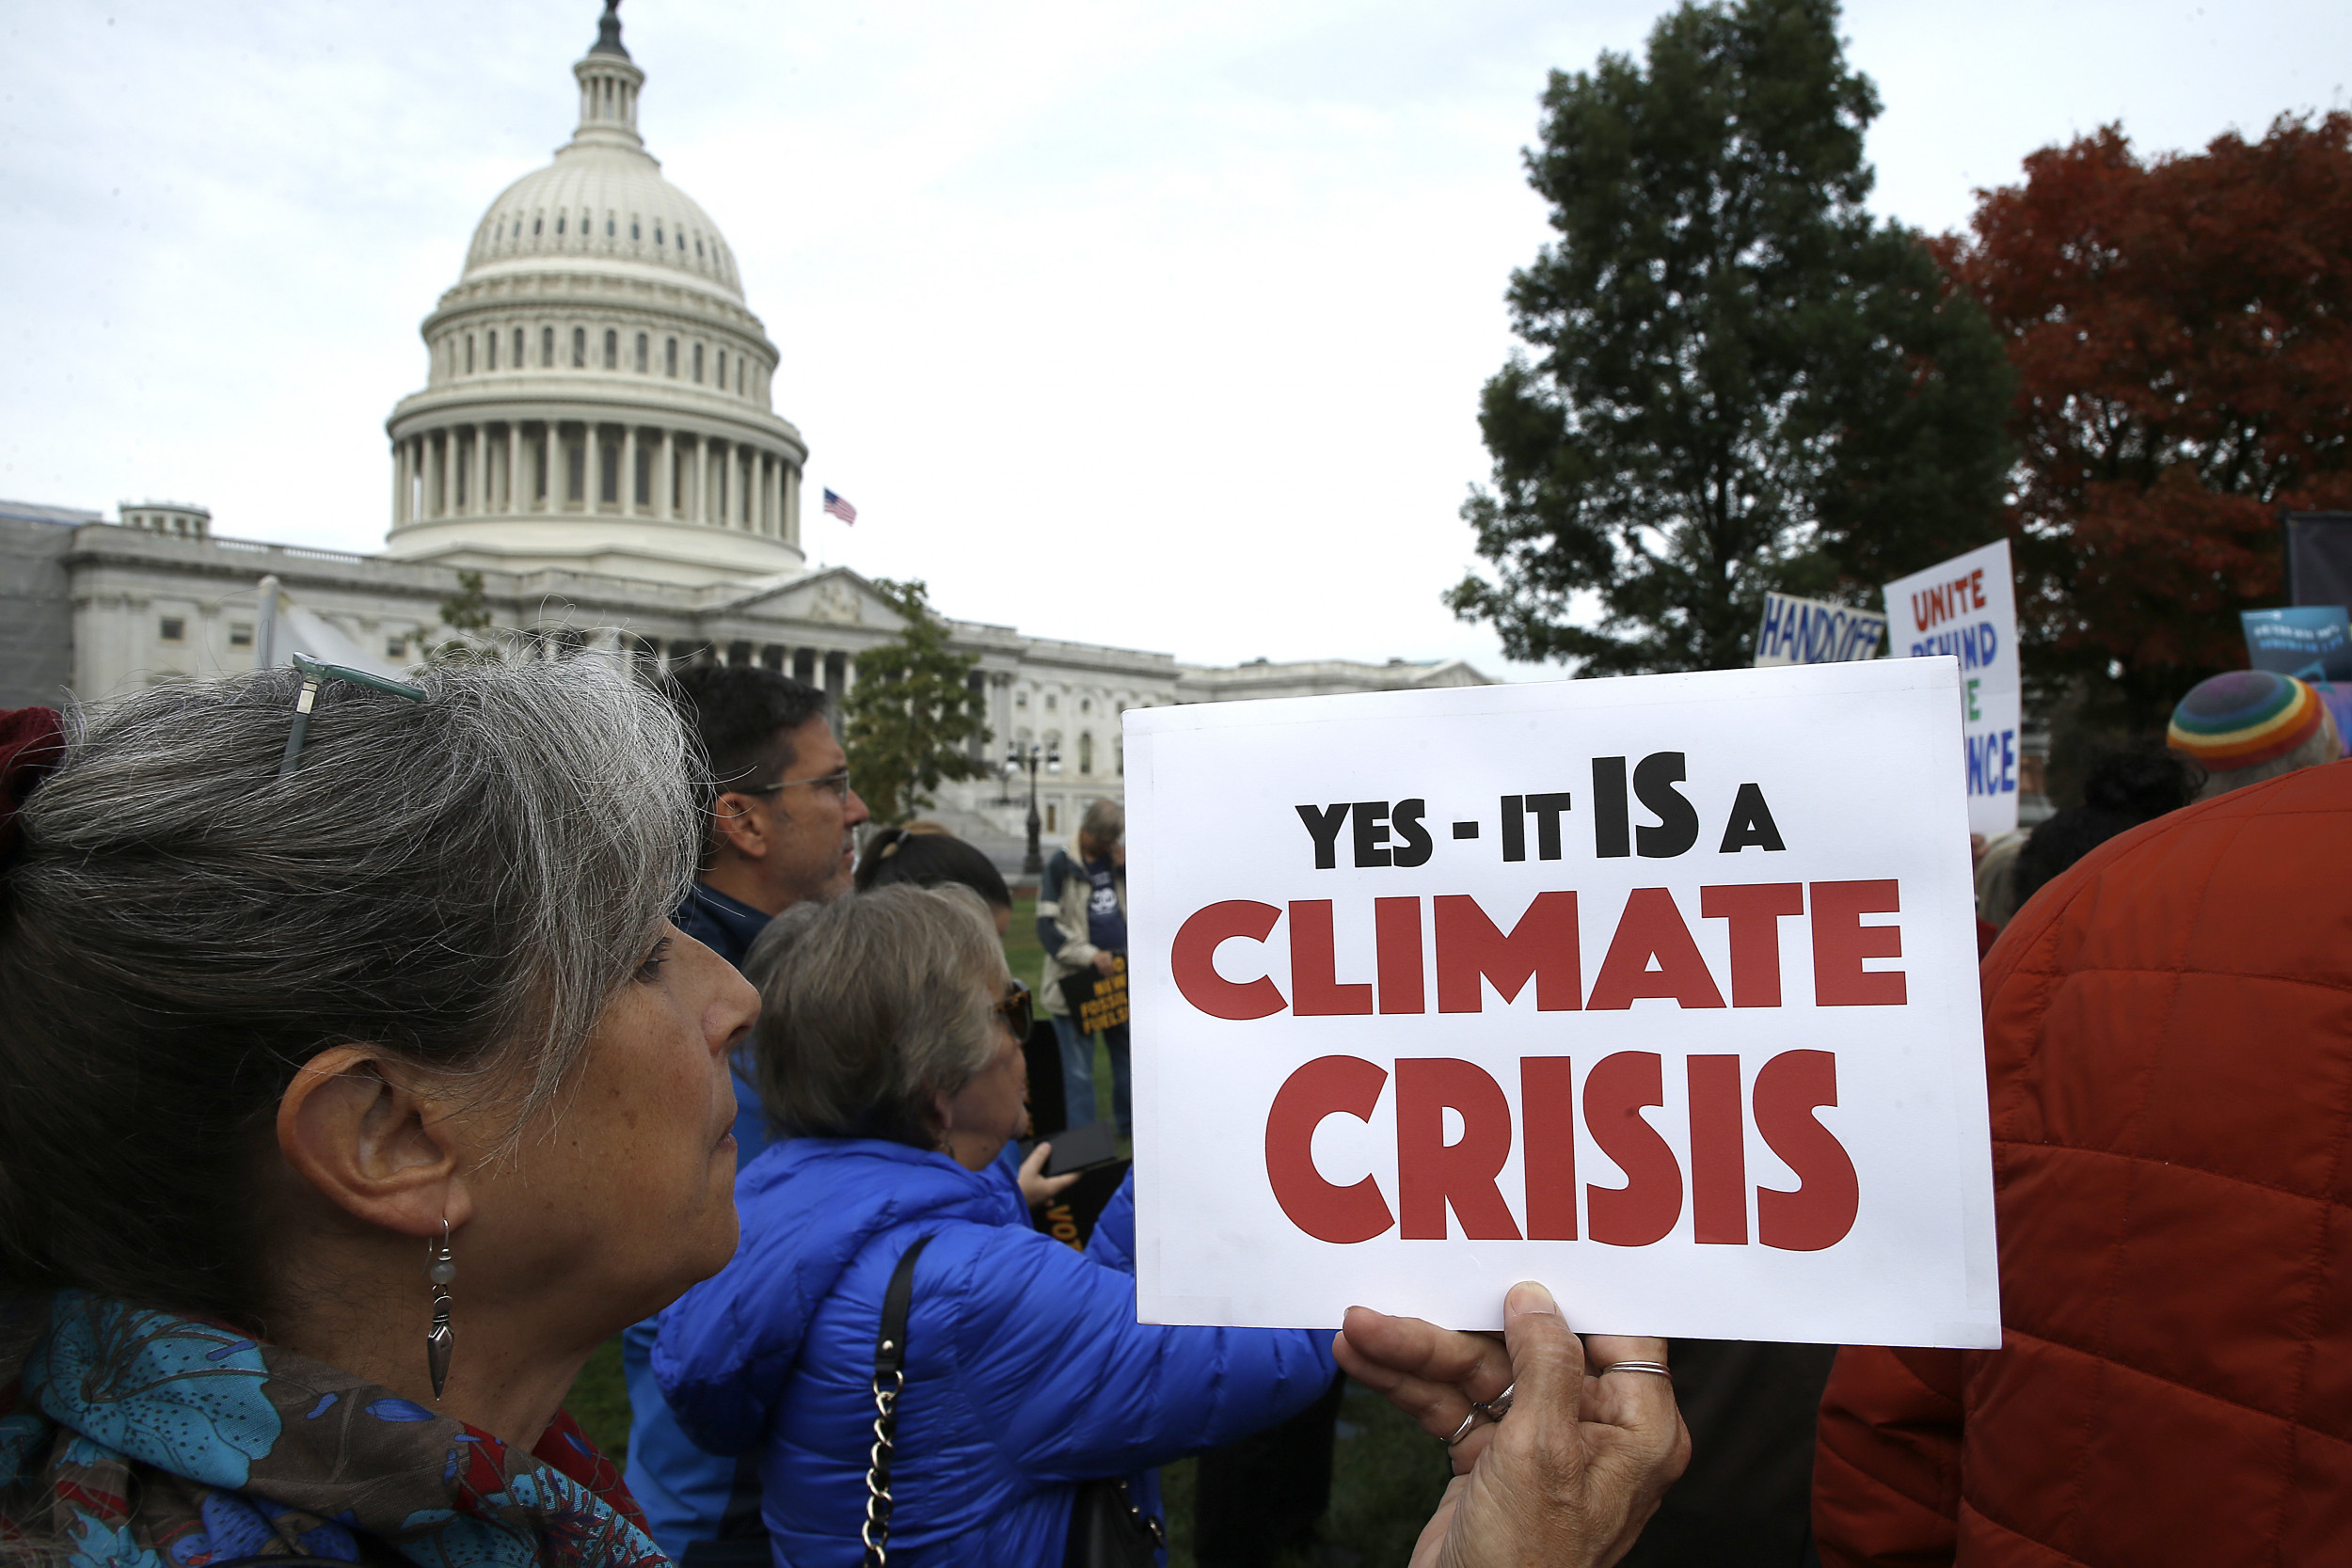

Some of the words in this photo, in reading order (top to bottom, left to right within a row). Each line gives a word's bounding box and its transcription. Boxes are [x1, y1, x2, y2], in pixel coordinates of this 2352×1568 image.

[1912, 568, 1986, 633] UNITE
[1295, 798, 1434, 870] YES
[1501, 792, 1572, 863] IT
[1591, 751, 1699, 860] IS
[1718, 783, 1787, 854] A
[1967, 728, 2015, 796] NCE
[1171, 879, 1908, 1022] CLIMATE
[1264, 1049, 1859, 1252] CRISIS
